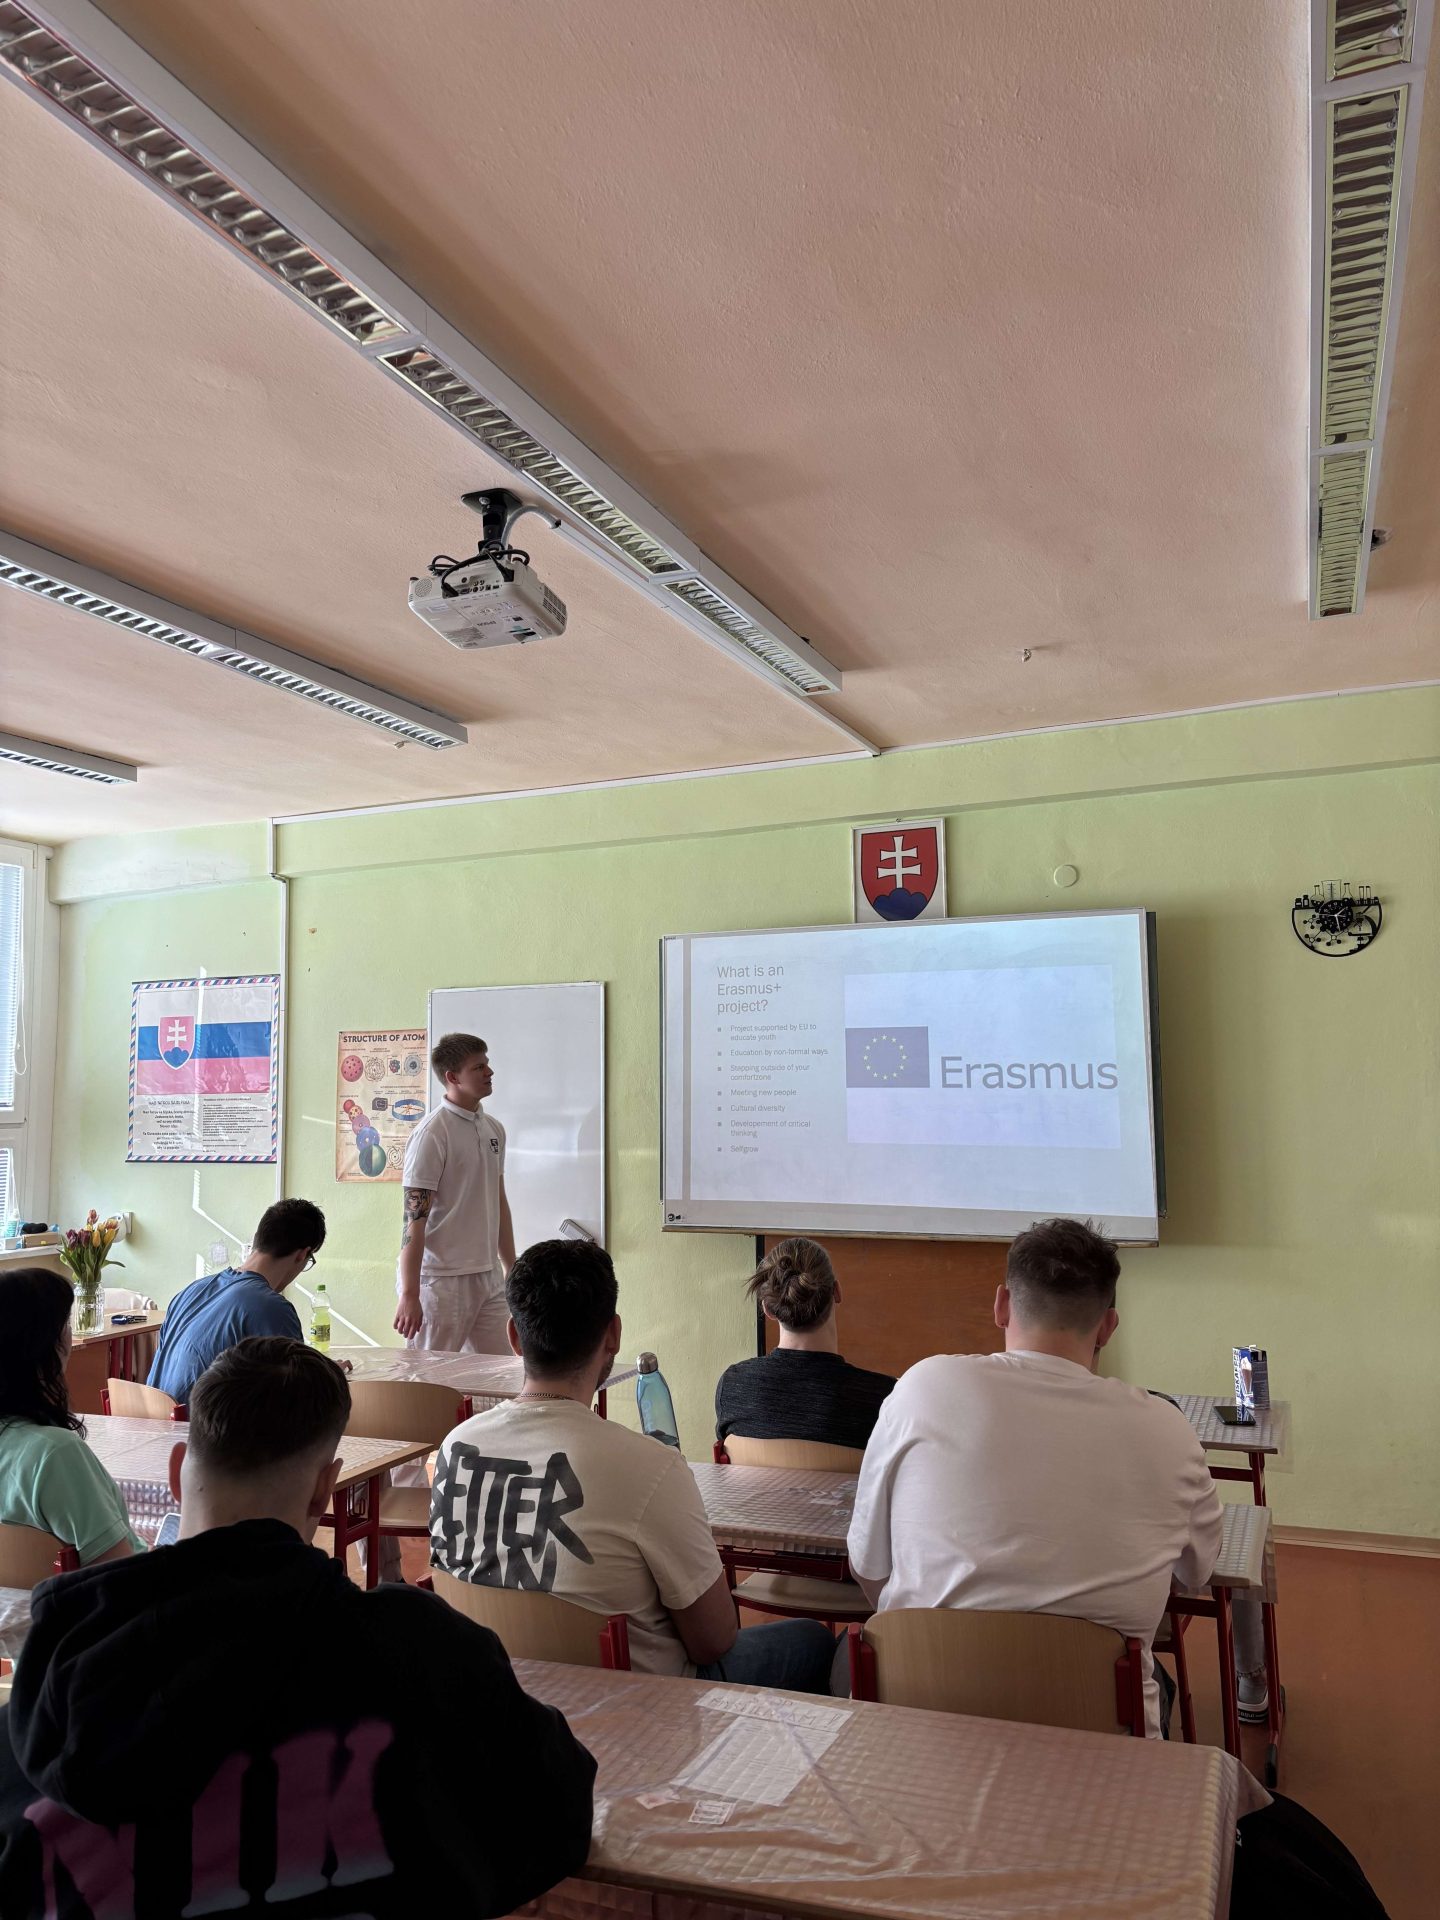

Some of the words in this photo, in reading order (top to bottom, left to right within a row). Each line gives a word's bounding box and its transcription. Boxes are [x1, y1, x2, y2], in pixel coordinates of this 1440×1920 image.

[716, 965, 750, 978] What
[754, 964, 764, 977] is
[768, 966, 784, 976] an
[717, 983, 782, 996] Erasmus+
[717, 999, 769, 1015] project?
[730, 1024, 753, 1033] Project
[754, 1024, 788, 1032] supported
[789, 1023, 798, 1031] by
[343, 1034, 387, 1043] STRUCTURE
[389, 1034, 400, 1042] OF
[402, 1033, 425, 1041] ATOM
[758, 1033, 777, 1041] youth
[730, 1048, 763, 1056] Education
[764, 1048, 772, 1056] by
[730, 1064, 760, 1072] Stepping
[795, 1064, 810, 1072] your
[940, 1056, 1119, 1090] Erasmus
[730, 1089, 758, 1097] Meeting
[773, 1089, 797, 1097] people
[730, 1104, 757, 1112] Cultural
[758, 1104, 786, 1113] diversity
[788, 1120, 811, 1128] critical
[730, 1130, 758, 1138] thinking
